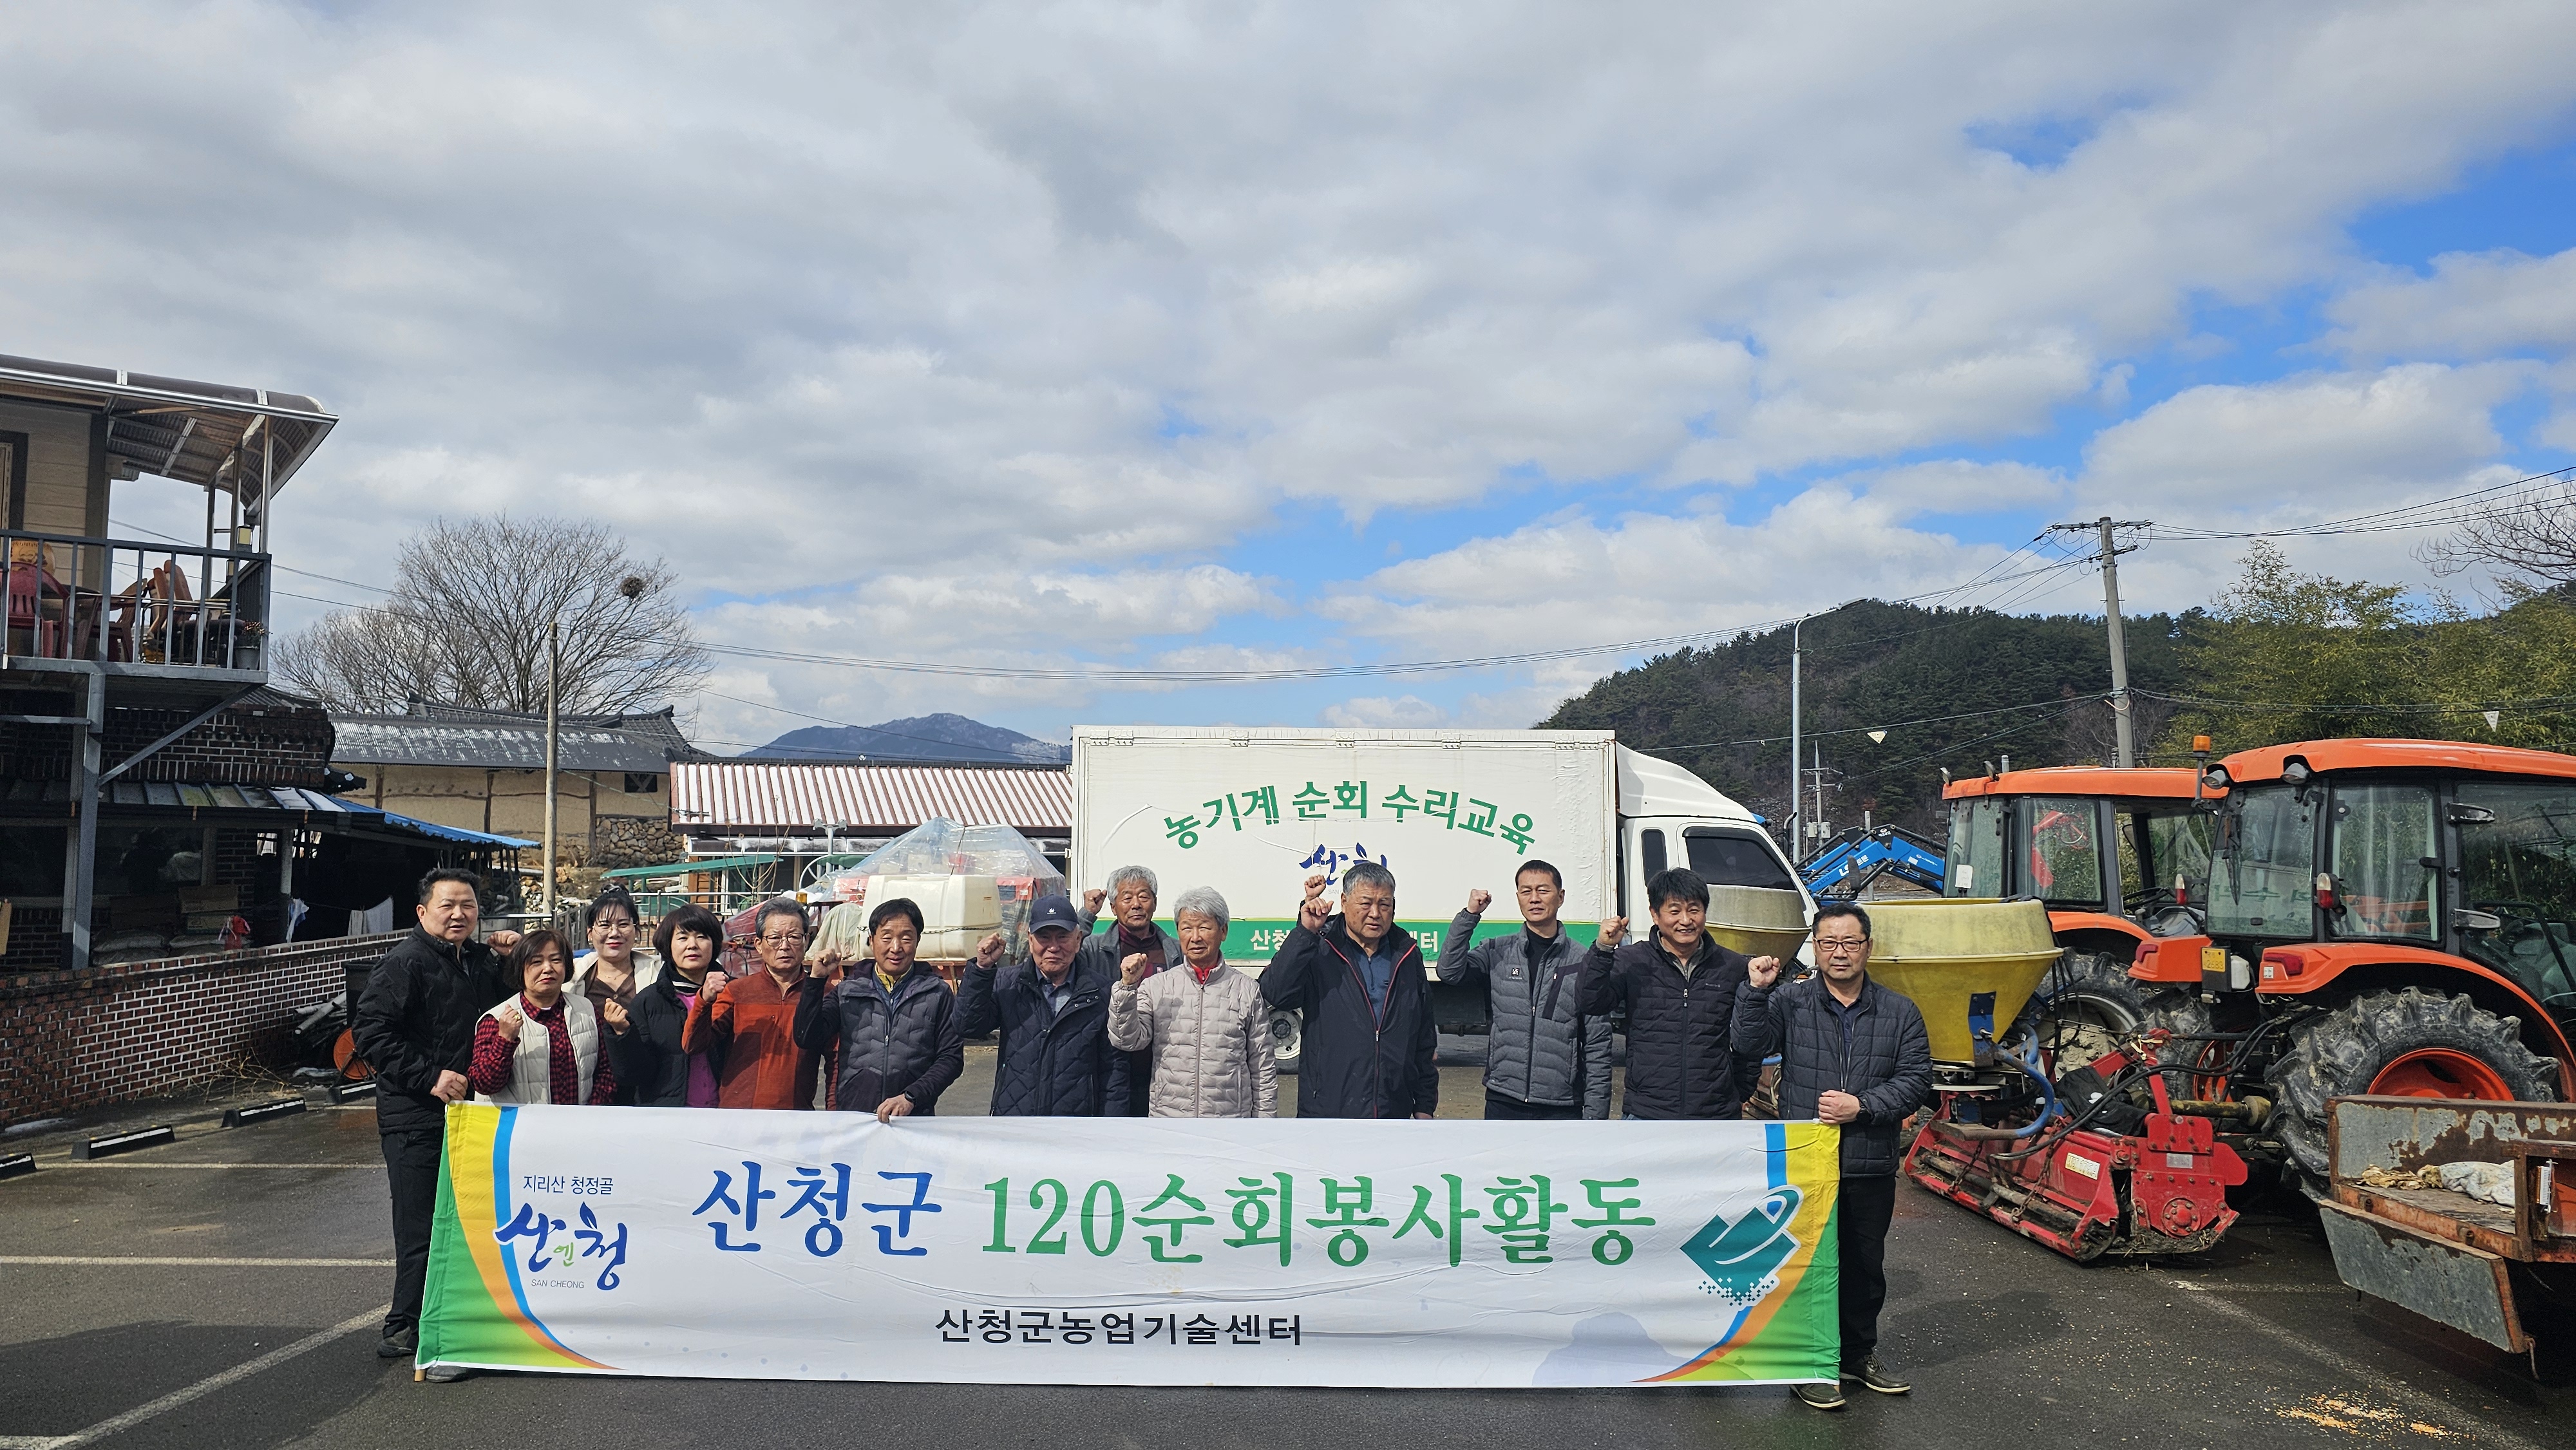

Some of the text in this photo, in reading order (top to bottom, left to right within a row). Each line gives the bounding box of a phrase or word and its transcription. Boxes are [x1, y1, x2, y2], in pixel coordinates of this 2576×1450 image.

[1164, 781, 1535, 855] 농기계 순회 수리교육
[523, 1175, 614, 1195] 지리산 청정골
[692, 1161, 1656, 1268] 산청군 120순회봉사활동
[531, 1279, 585, 1288] SAN CHEONG
[934, 1308, 1300, 1346] 산청군농업기술센터
